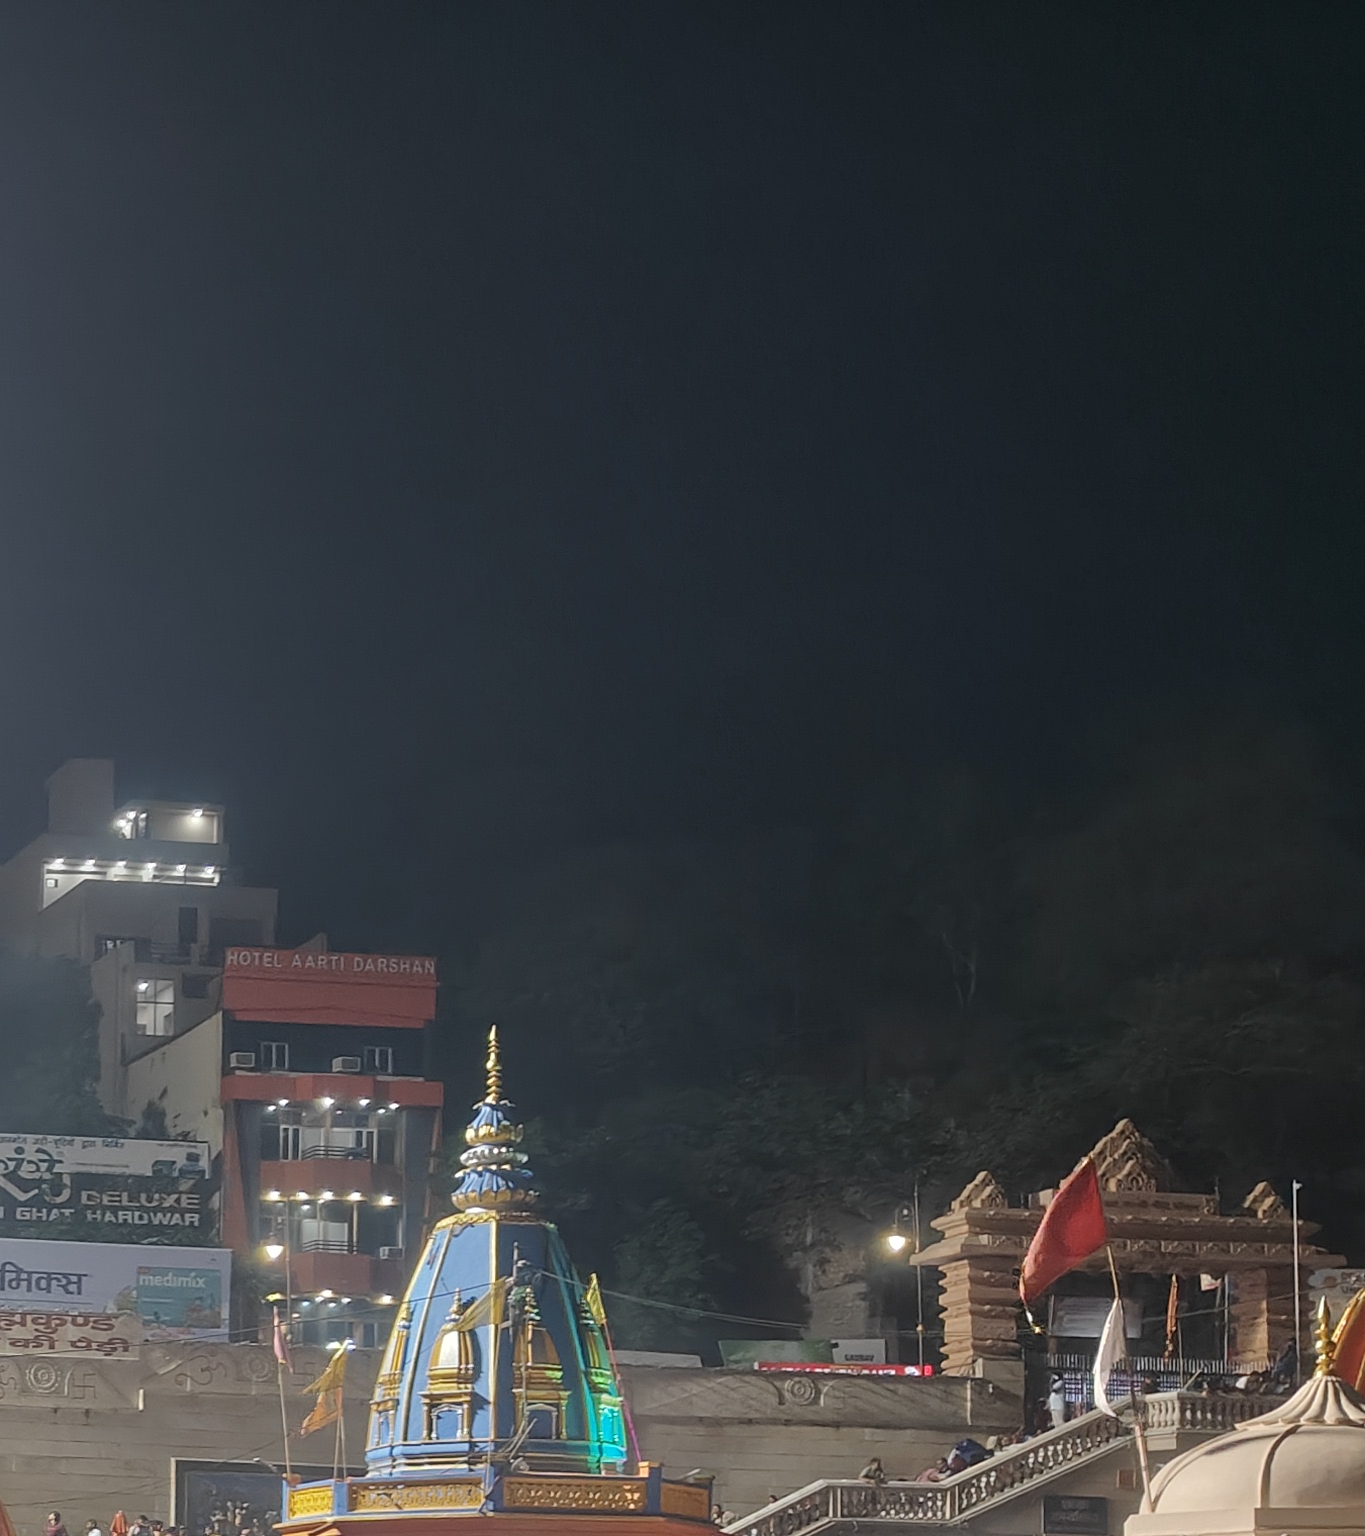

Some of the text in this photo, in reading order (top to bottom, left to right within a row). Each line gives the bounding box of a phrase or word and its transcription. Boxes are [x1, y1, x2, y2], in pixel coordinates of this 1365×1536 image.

[227, 951, 436, 975] HOTEL AARTI DARSHAN
[81, 1190, 201, 1210] DELUXE
[15, 1206, 75, 1222] GHAT
[85, 1210, 201, 1227] HARDWAR
[139, 1271, 207, 1289] medimix
[8, 1333, 58, 1350] की
